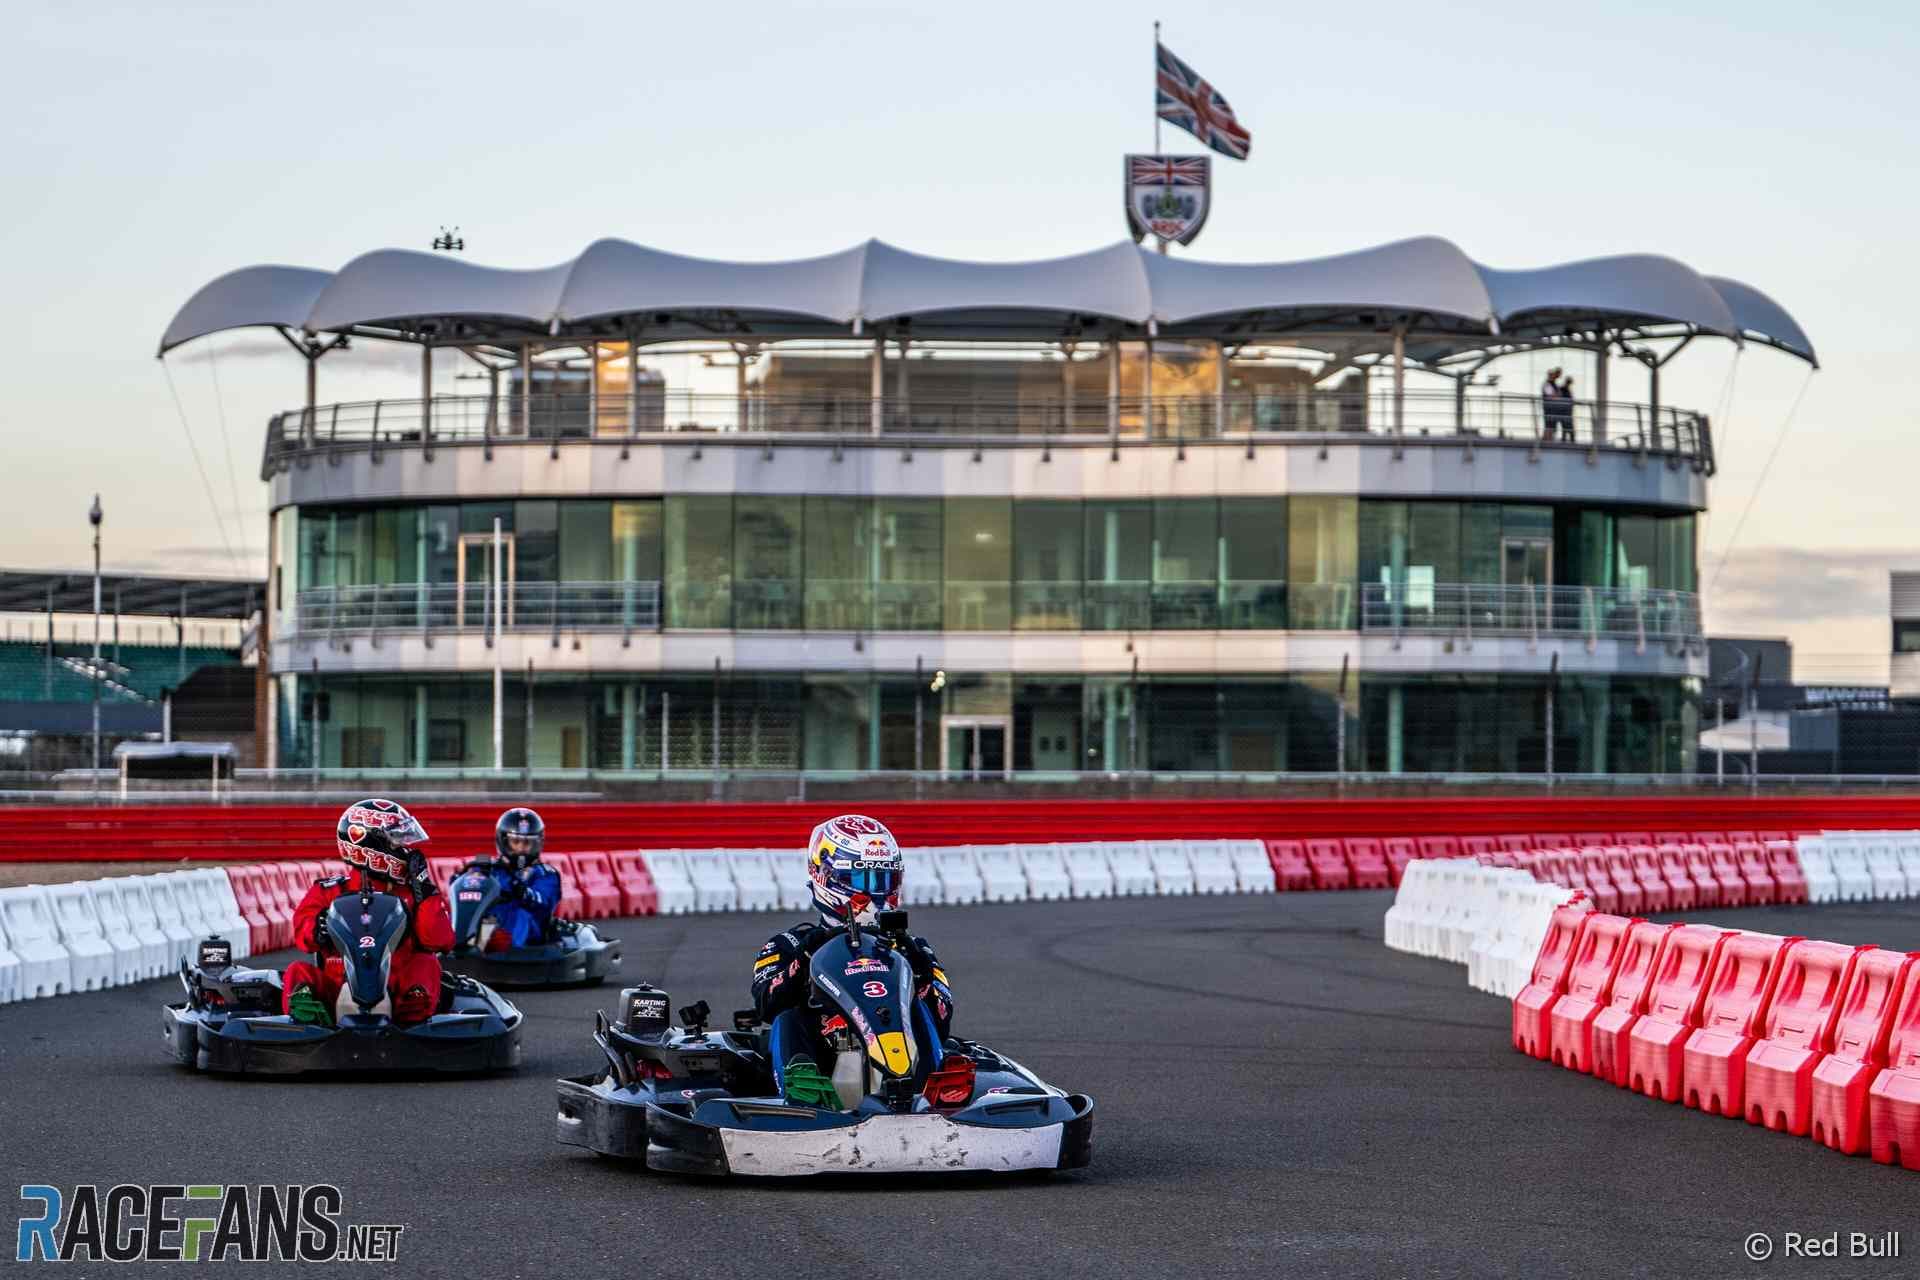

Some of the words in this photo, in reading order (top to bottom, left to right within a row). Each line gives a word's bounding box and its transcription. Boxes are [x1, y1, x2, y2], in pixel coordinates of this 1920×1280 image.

[864, 848, 879, 857] Red
[854, 860, 901, 870] ORACLE
[359, 935, 376, 948] 2
[845, 965, 868, 976] Red
[868, 963, 890, 974] Bull
[863, 981, 888, 998] 3
